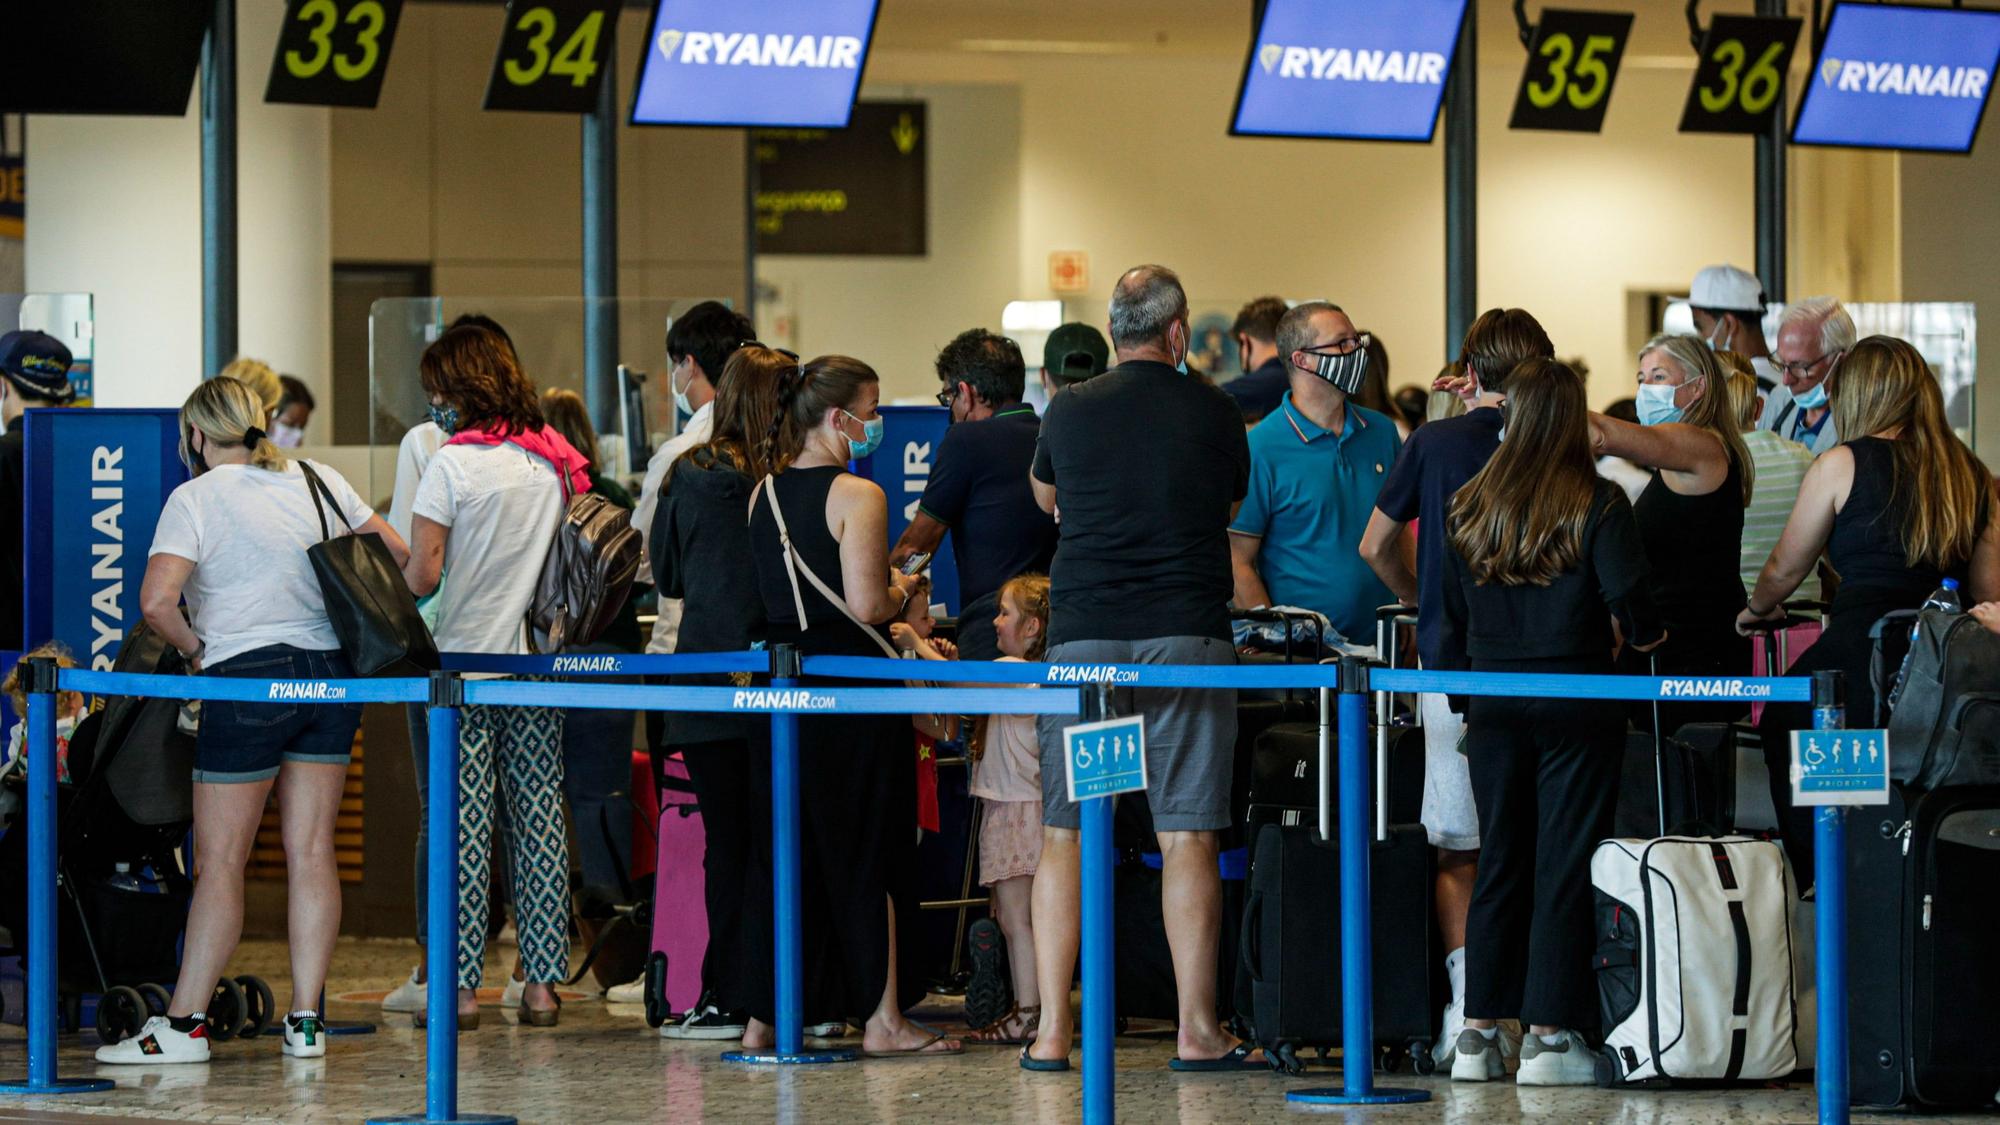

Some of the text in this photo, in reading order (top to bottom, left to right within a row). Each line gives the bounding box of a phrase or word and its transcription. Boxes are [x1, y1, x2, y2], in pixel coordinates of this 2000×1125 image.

[286, 0, 385, 80] 33
[504, 7, 604, 86] 34
[680, 31, 861, 68] RYANAIR
[1279, 46, 1446, 84] RYANAIR
[1527, 33, 1614, 109] 35
[1700, 39, 1784, 113] 36
[1838, 60, 1988, 98] RYANAIR
[268, 682, 346, 699] RYANAIR.COM
[1047, 665, 1139, 682] RYANAIR.COM
[1660, 679, 1771, 696] RYANAIR.COM
[733, 691, 836, 709] RYANAIR.COM
